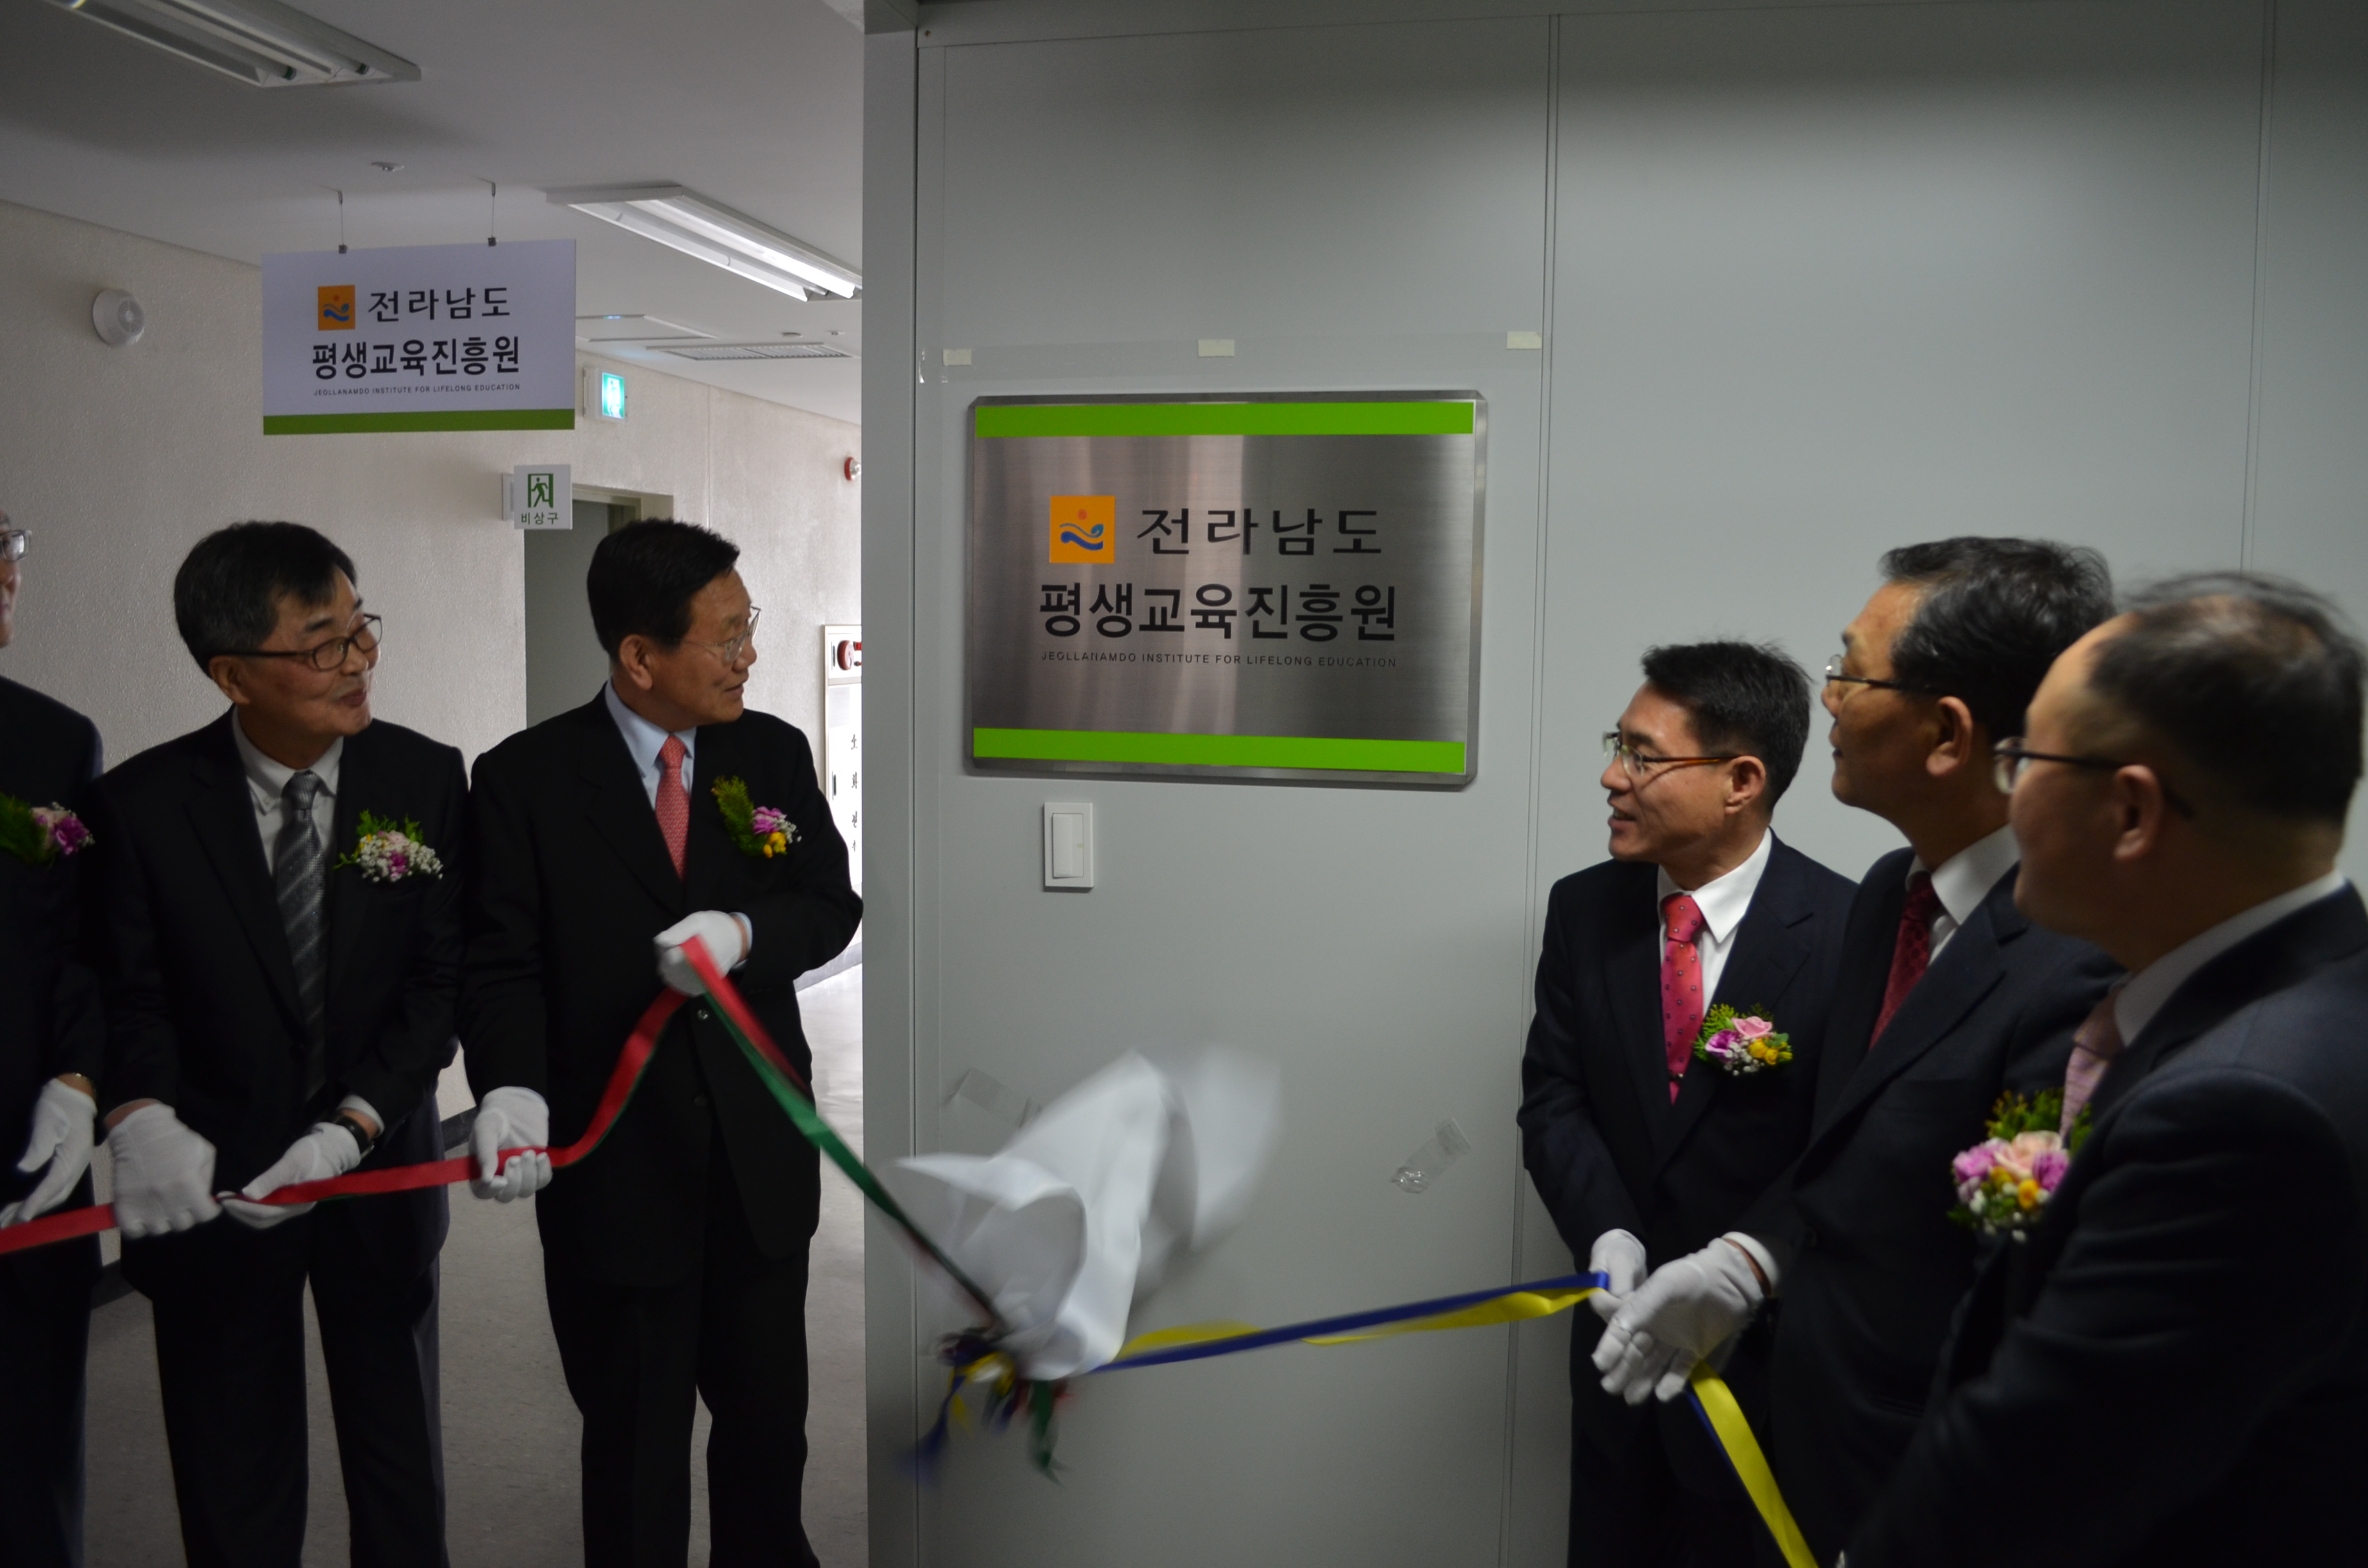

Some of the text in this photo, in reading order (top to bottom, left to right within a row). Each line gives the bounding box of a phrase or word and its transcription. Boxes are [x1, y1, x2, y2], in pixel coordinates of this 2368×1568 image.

[368, 287, 511, 323] 전라남도
[312, 336, 519, 380] 평생교육진흥원
[521, 512, 559, 525] 비상구
[1137, 508, 1382, 555] 전라남도
[1039, 582, 1395, 642] 평생교육진흥원
[1041, 651, 1397, 667] JEOLLANAMDO INSTITUTE FOR LIFELONG EDUCATION
